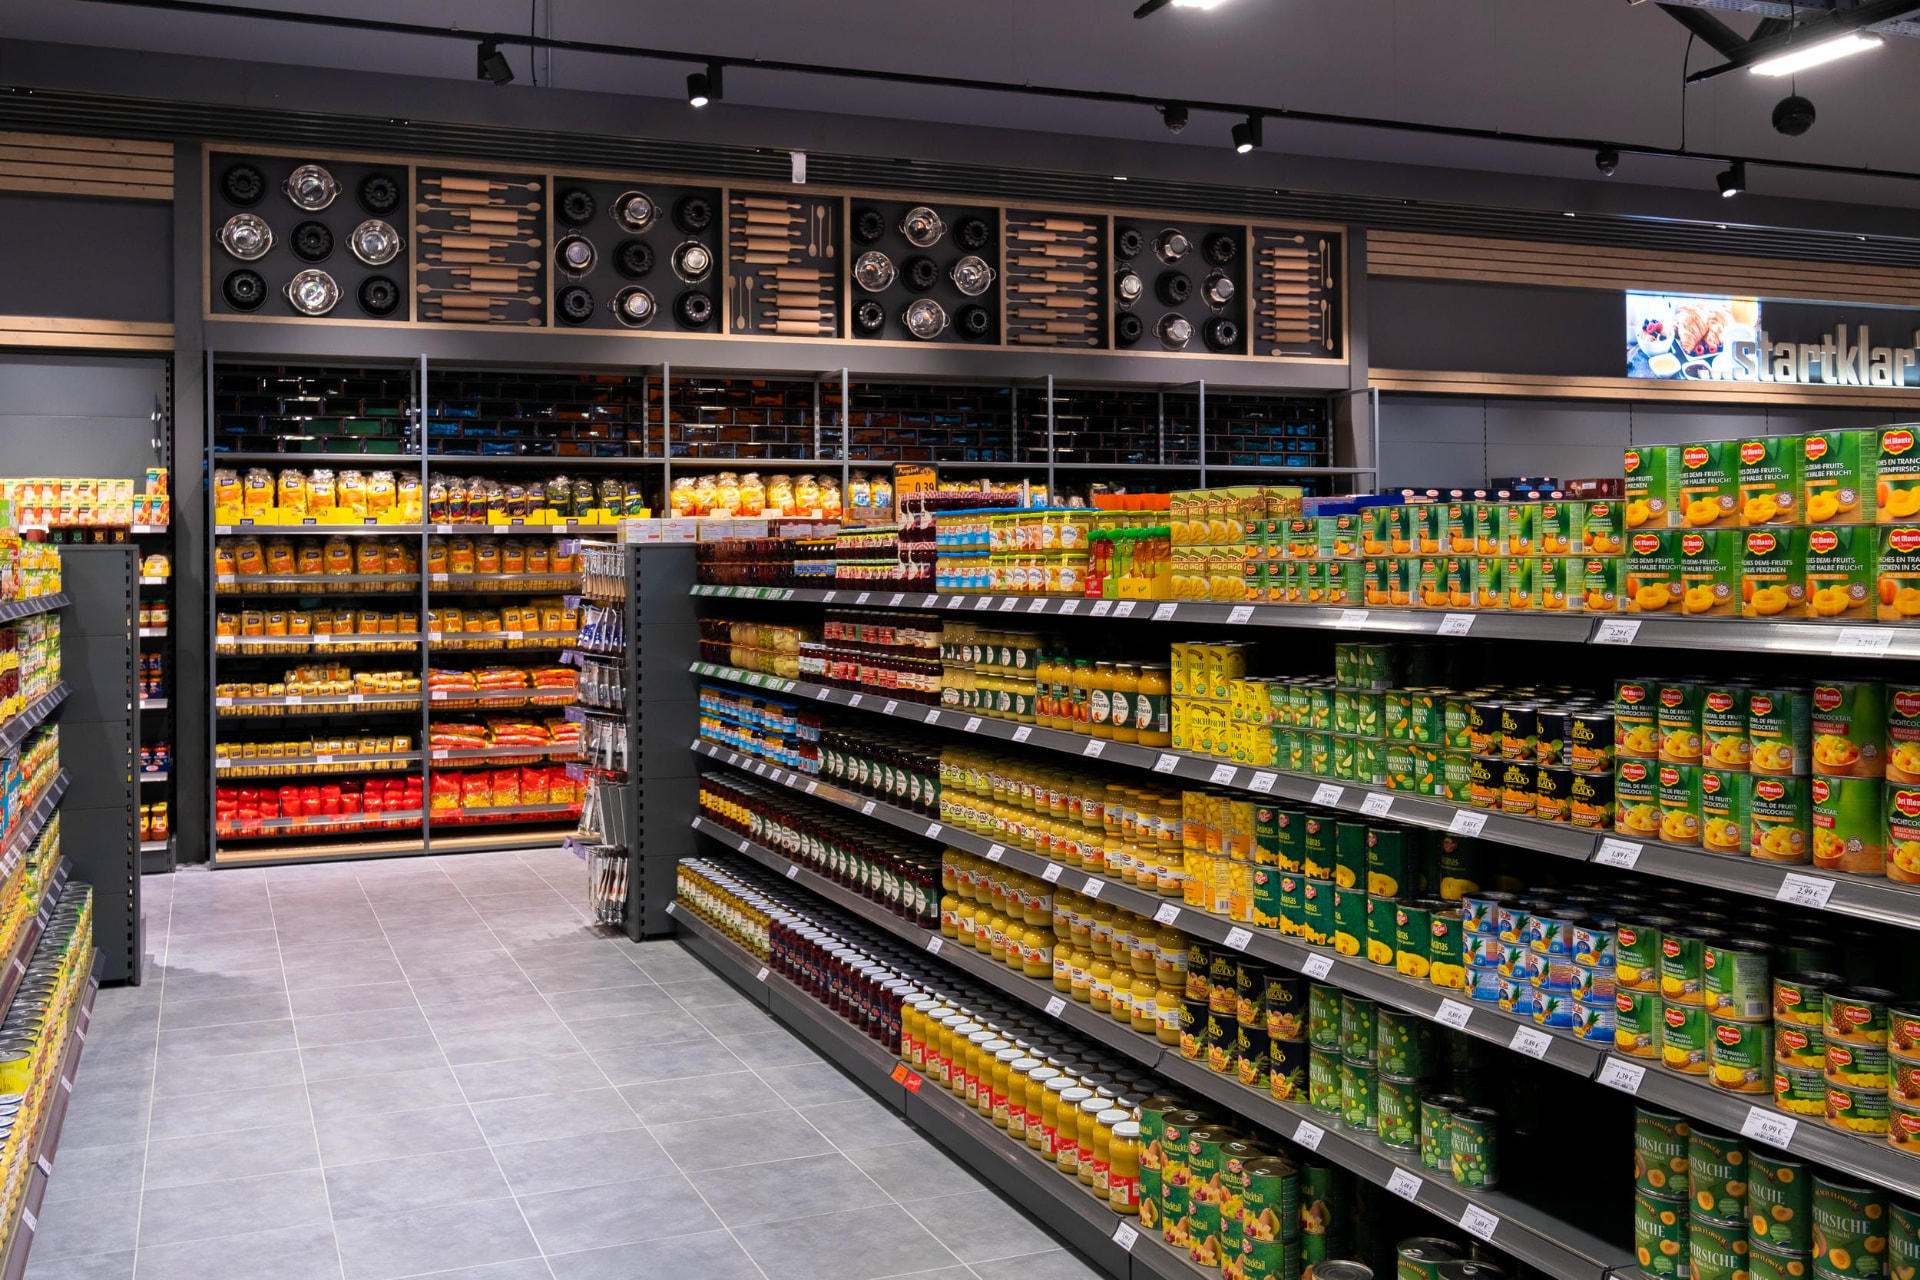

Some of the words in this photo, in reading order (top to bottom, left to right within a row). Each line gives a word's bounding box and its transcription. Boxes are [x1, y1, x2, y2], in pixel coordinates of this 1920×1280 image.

[1797, 888, 1812, 896] 2,99
[1762, 1124, 1777, 1133] 0,99
[1635, 1134, 1683, 1157] IRSICHE
[1812, 1206, 1872, 1235] FIRSICHE
[1690, 1241, 1738, 1269] IRSICHE
